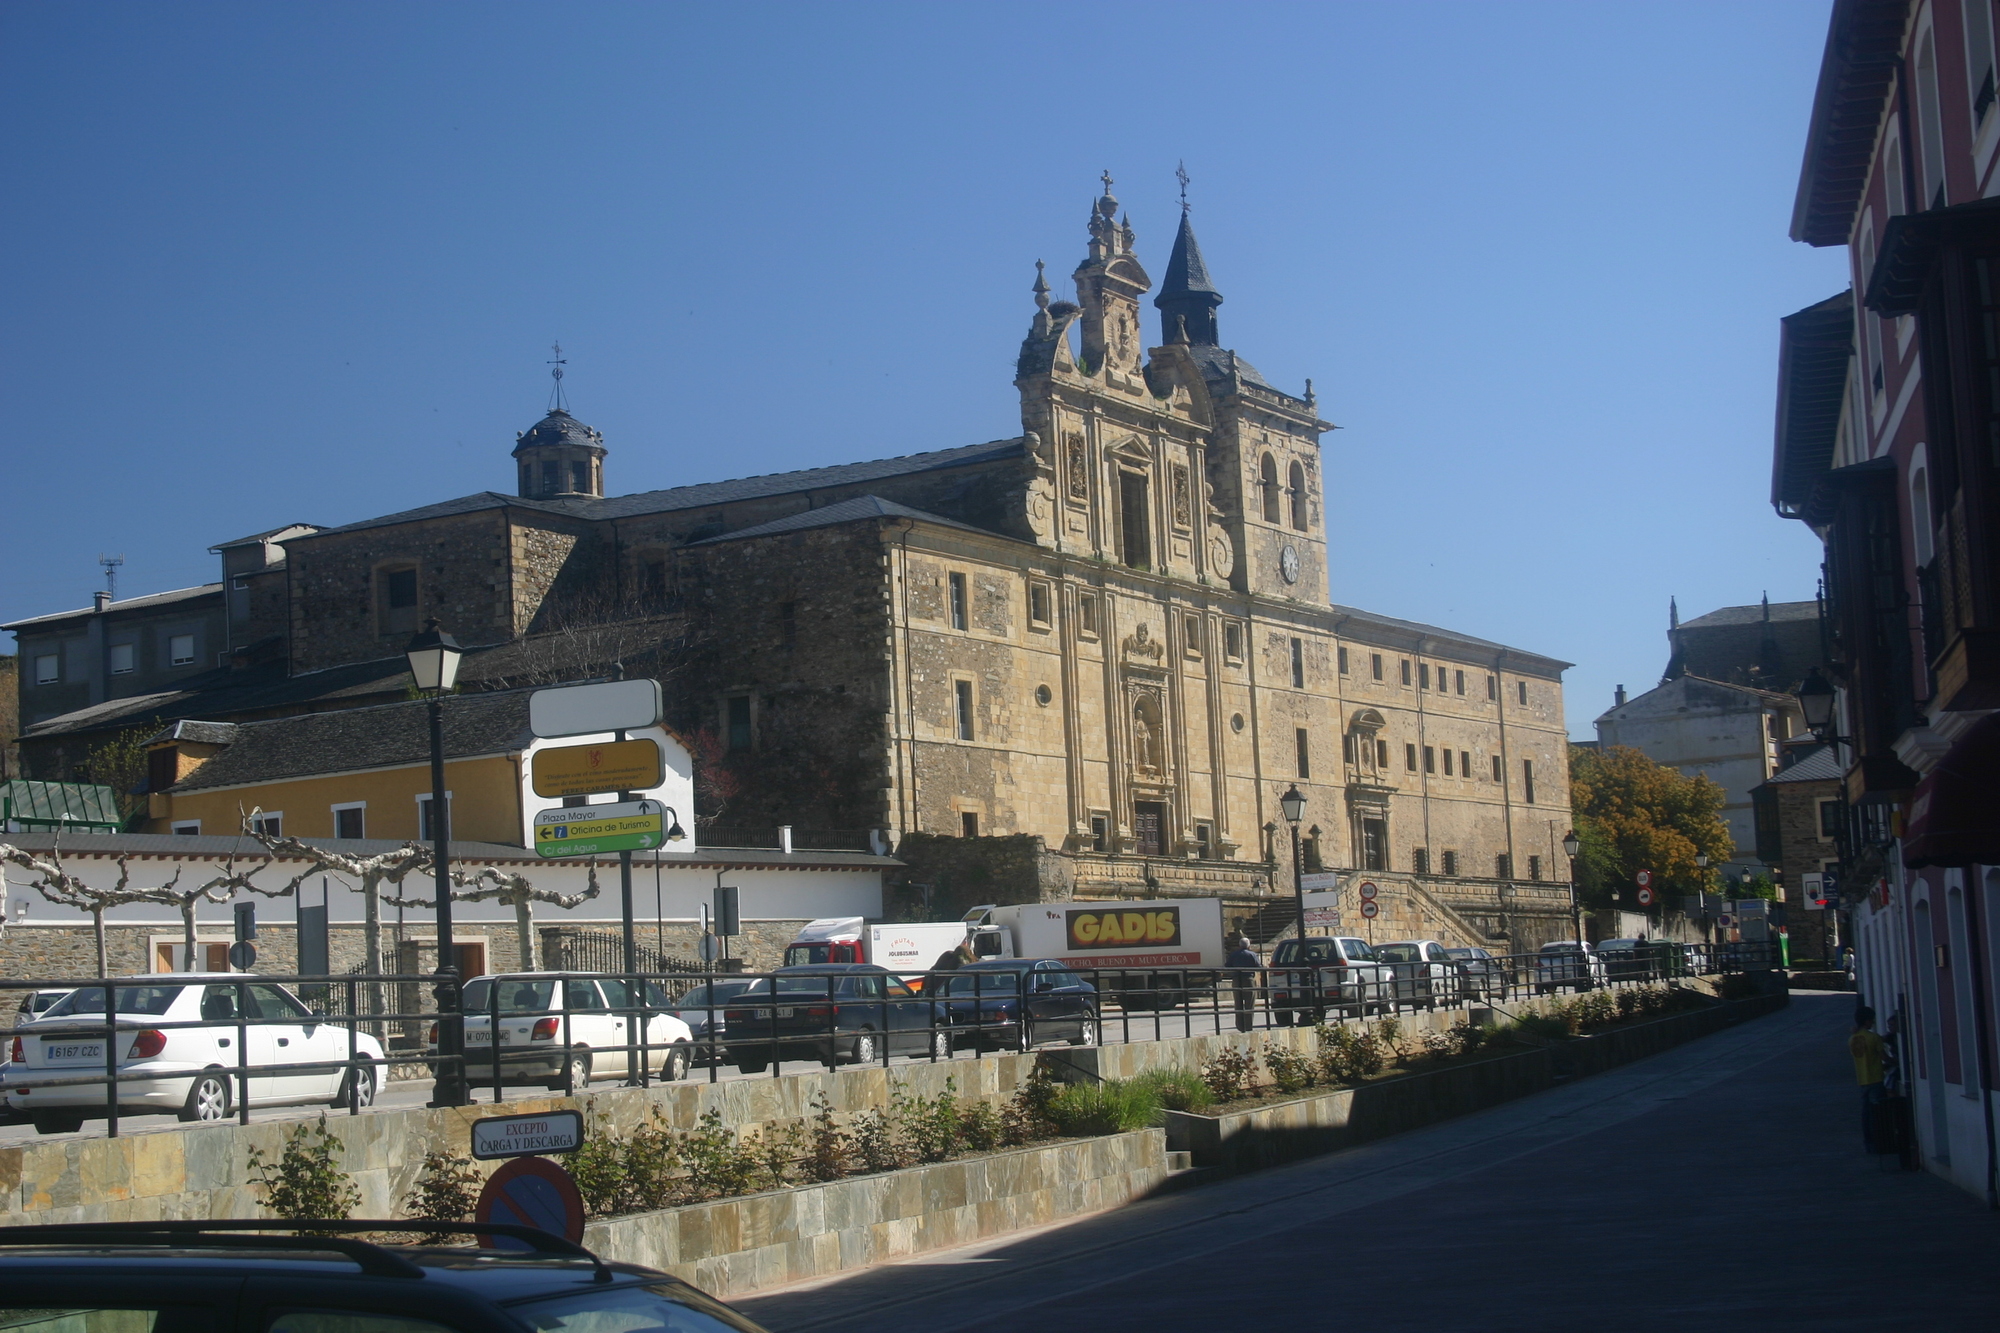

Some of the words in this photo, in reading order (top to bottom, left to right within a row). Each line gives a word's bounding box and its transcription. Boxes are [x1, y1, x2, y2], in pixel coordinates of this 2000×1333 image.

[542, 814, 566, 823] Plaza
[568, 811, 596, 821] Mayor
[570, 826, 602, 835] Oficina
[619, 820, 650, 830] Turismo
[544, 846, 554, 855] C/
[557, 845, 571, 854] del
[574, 843, 597, 854] Agua
[1072, 912, 1176, 943] GADIS
[890, 938, 915, 948] FRUTAS
[1098, 958, 1126, 966] BUENO
[1160, 955, 1188, 963] CERCA
[55, 1047, 78, 1057] 6167
[82, 1046, 99, 1056] CZC
[506, 1122, 548, 1136] EXCEPTO
[480, 1140, 512, 1152] CARGA
[515, 1139, 521, 1149] Y
[523, 1134, 573, 1149] DESCARGA
